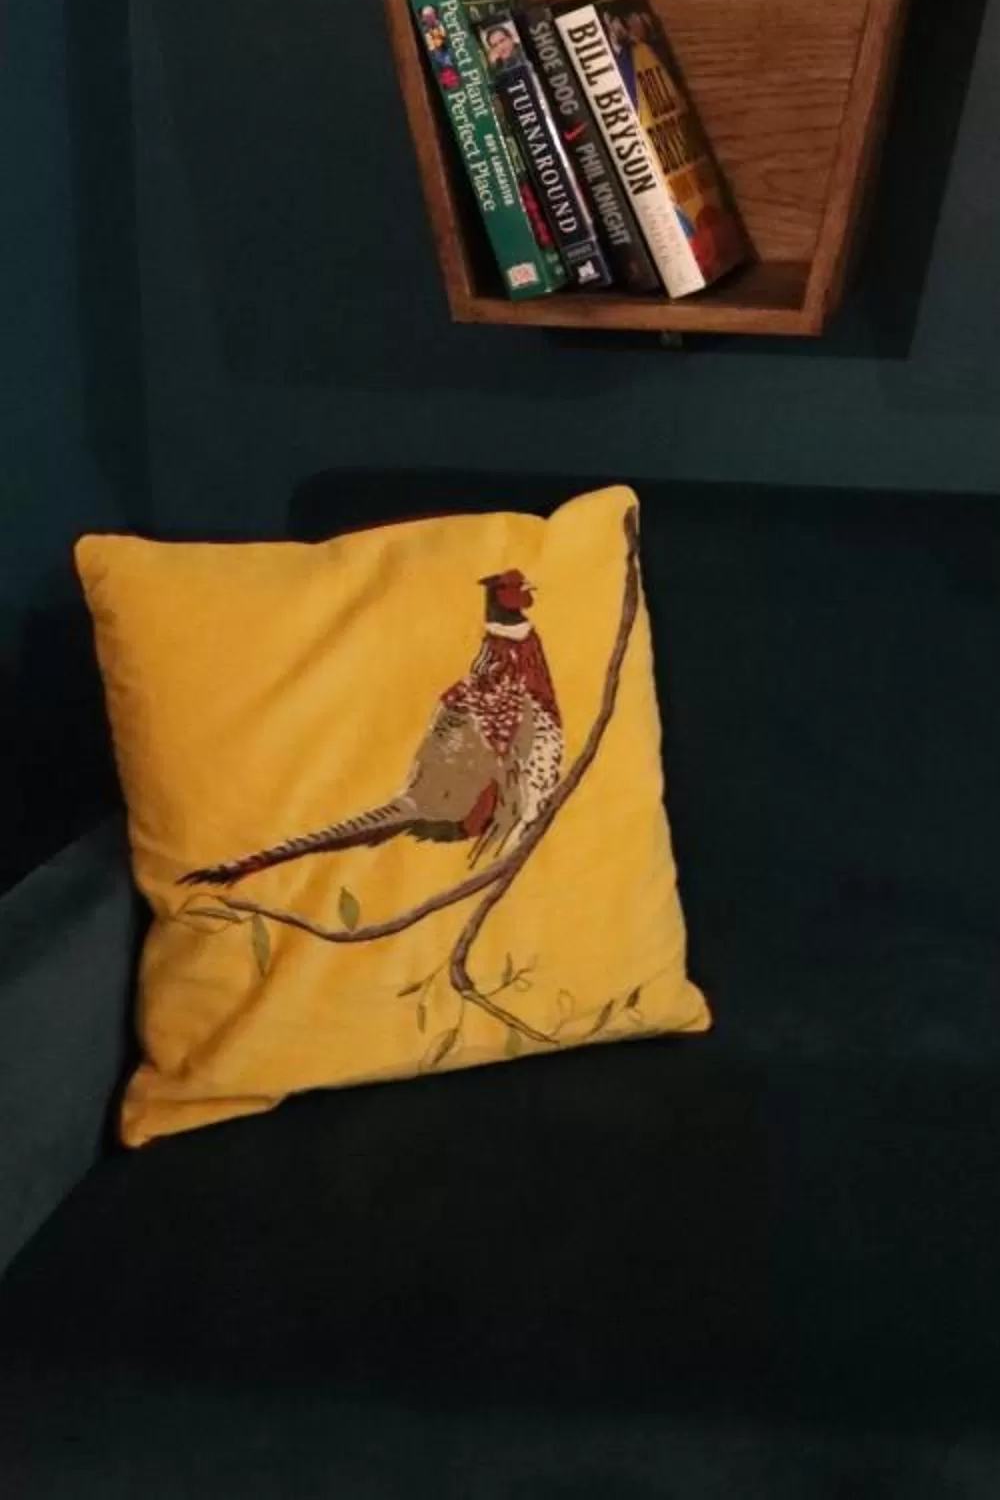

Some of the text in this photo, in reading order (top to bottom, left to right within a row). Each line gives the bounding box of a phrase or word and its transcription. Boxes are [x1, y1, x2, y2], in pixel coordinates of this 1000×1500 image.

[445, 88, 502, 214] Perfect Place
[459, 66, 493, 119] Plant
[507, 80, 577, 233] TURNAROUND
[528, 19, 632, 249] SHOE DOG PHIL KNIGHT
[568, 19, 655, 196] BILL BRYSON
